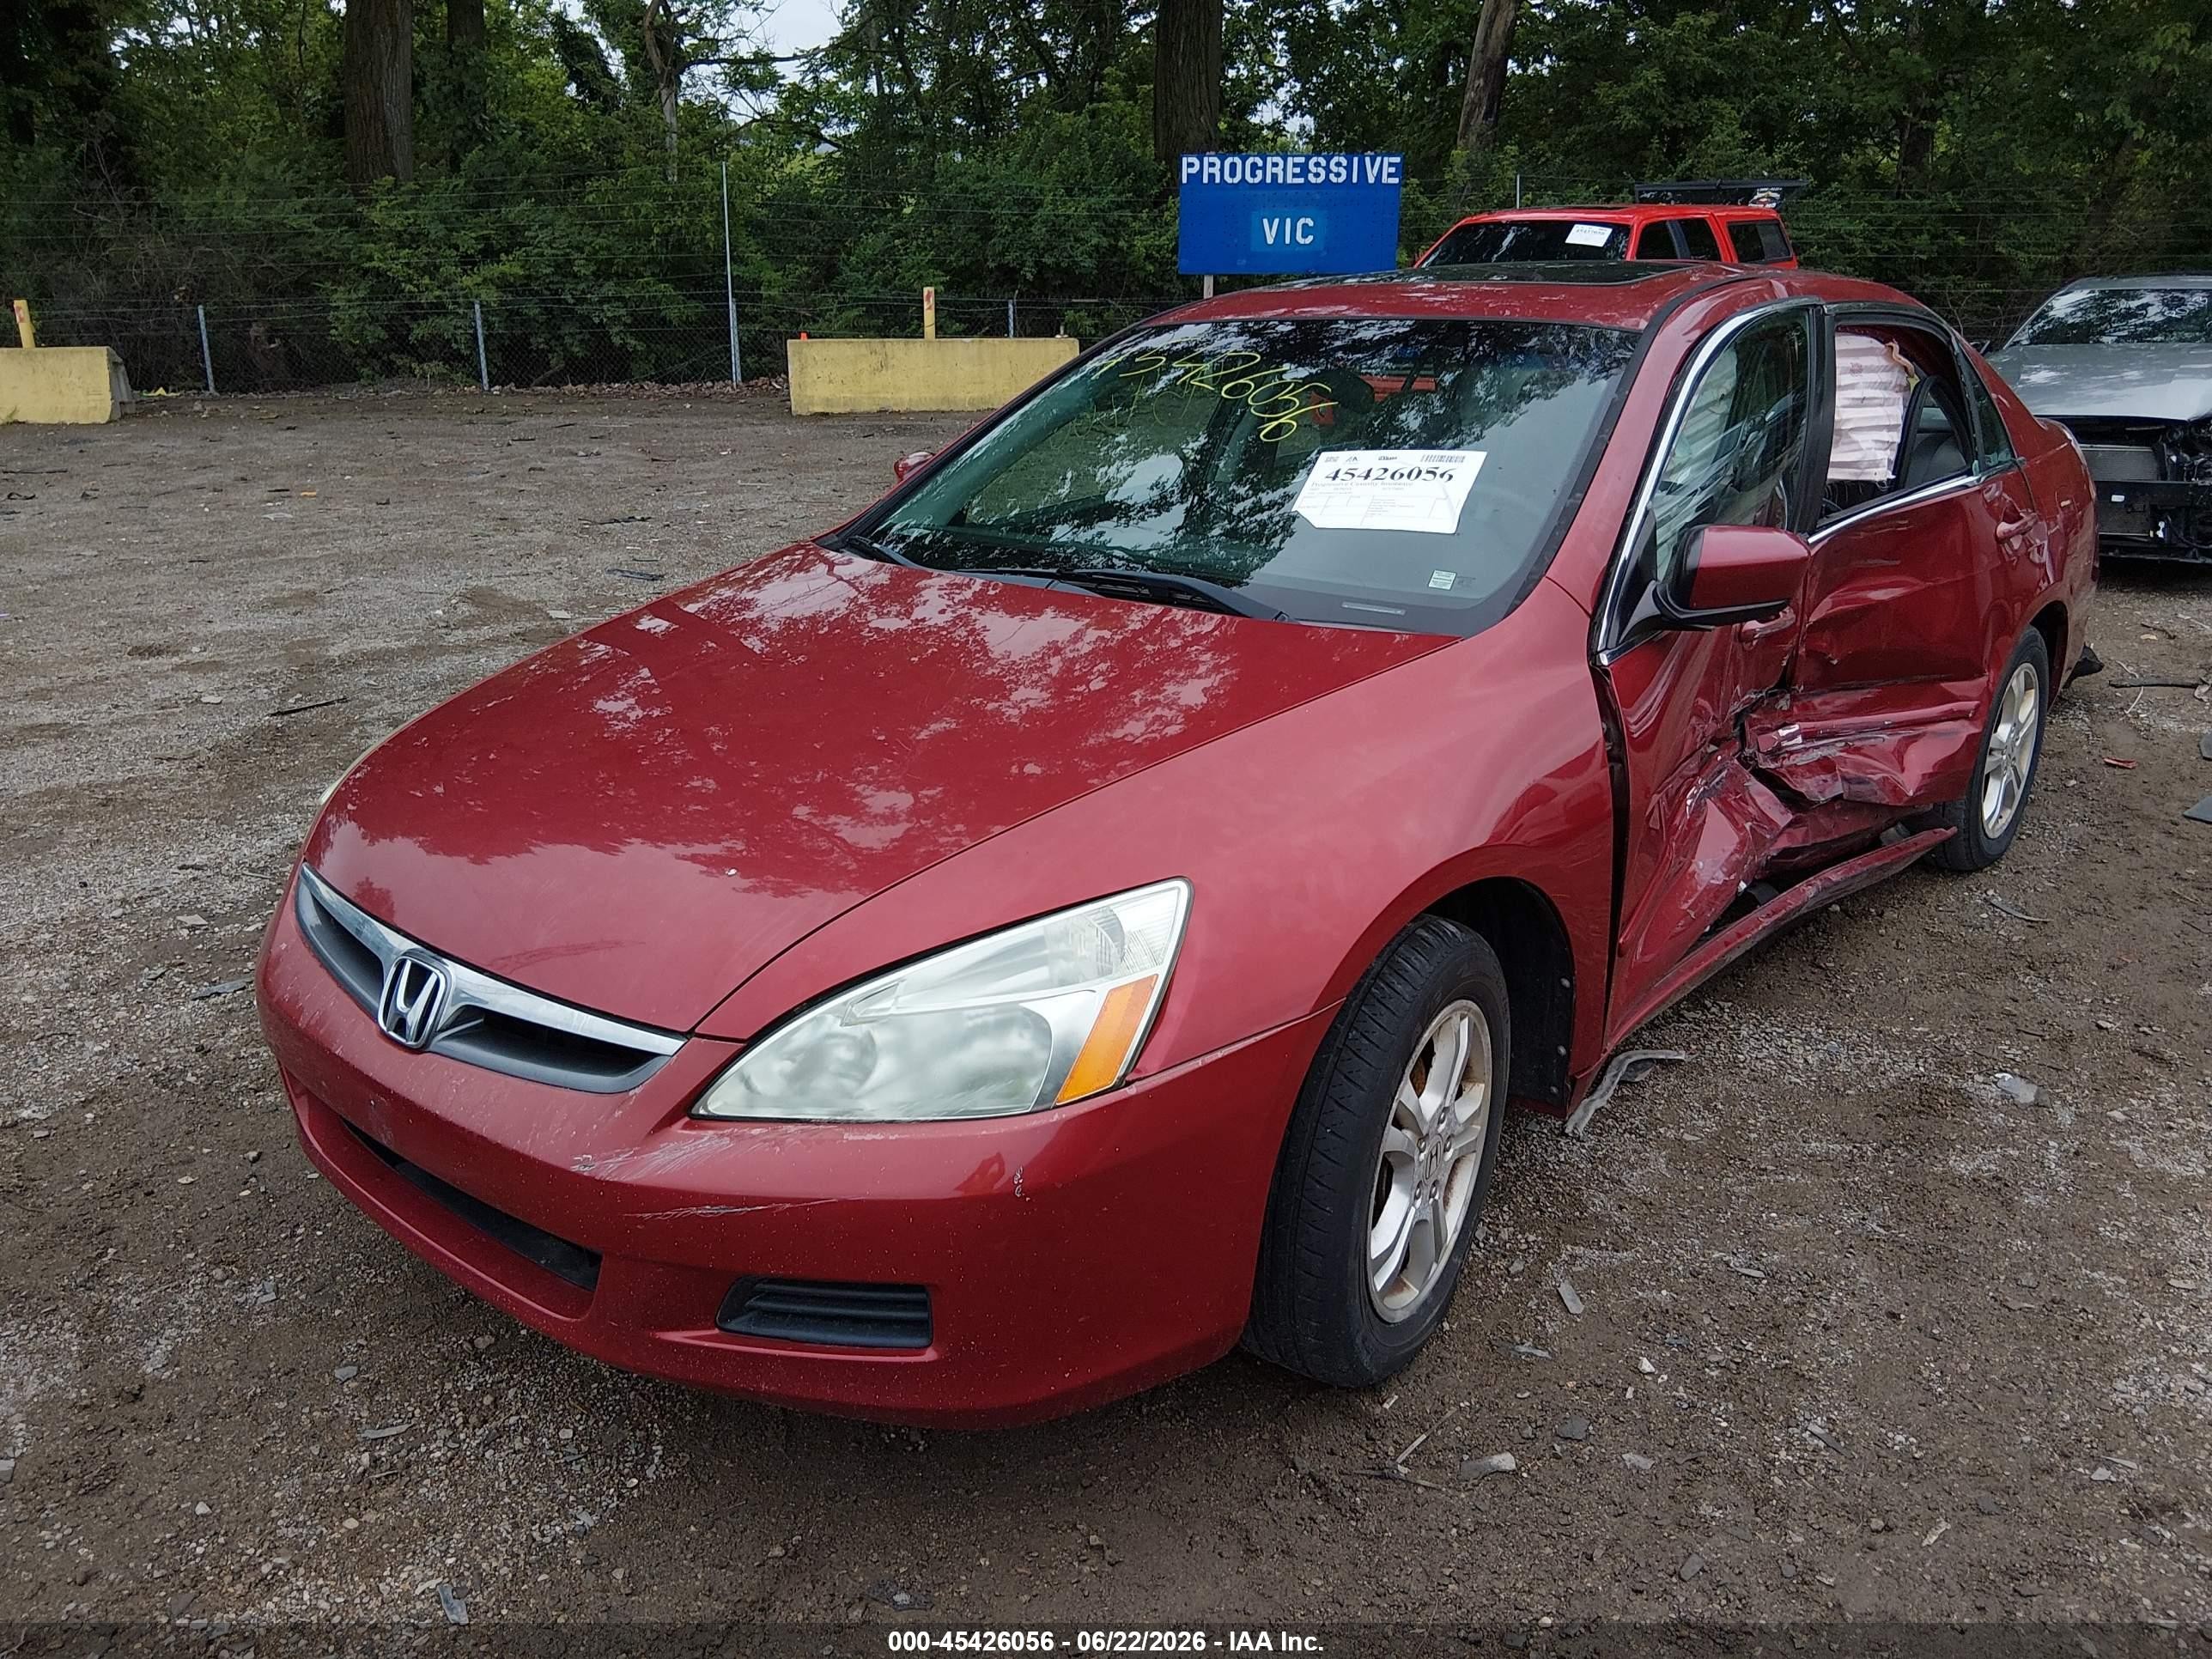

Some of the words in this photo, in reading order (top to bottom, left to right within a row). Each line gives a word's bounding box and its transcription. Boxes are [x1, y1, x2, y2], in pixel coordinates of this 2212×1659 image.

[1182, 156, 1401, 185] PROGRESSIVE
[1262, 217, 1314, 246] VIC
[1325, 466, 1457, 483] 45426056
